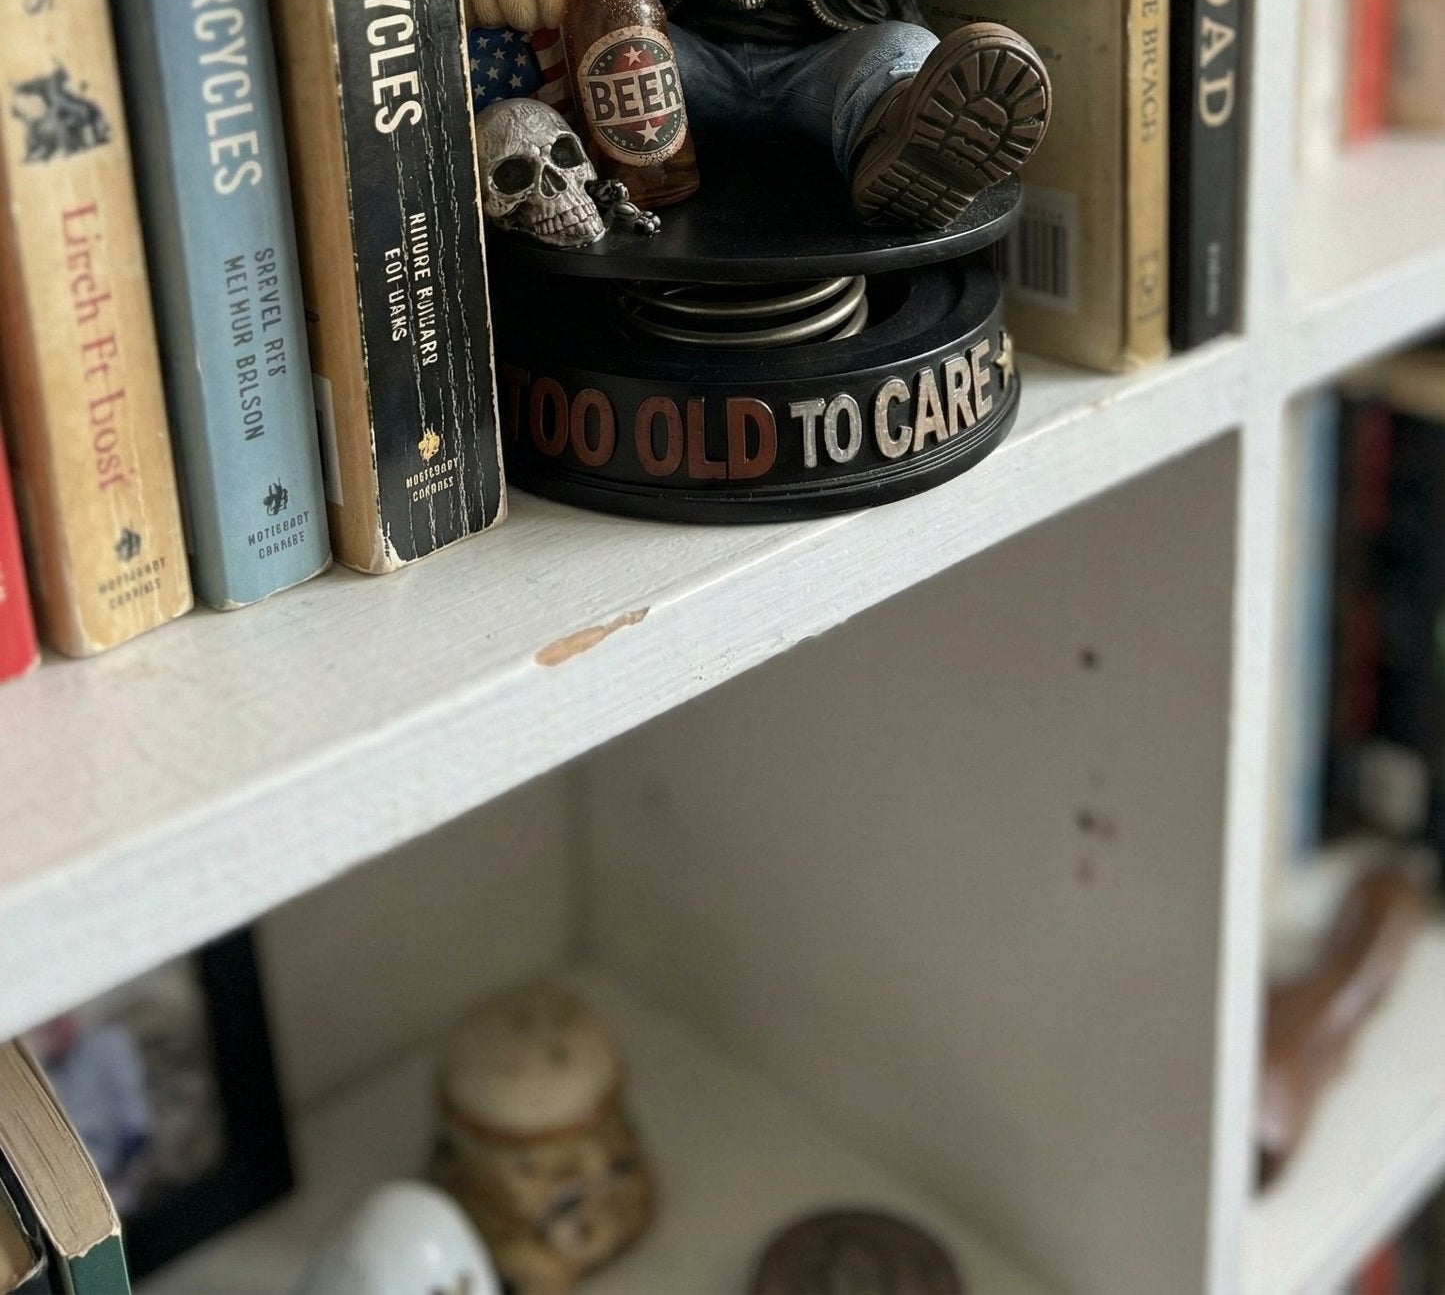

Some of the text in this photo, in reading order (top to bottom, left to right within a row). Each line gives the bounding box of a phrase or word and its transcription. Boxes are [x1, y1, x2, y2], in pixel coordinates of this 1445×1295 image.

[588, 67, 682, 121] BEER
[635, 395, 777, 480] OLD
[789, 392, 863, 469] TO
[873, 338, 994, 460] CARE
